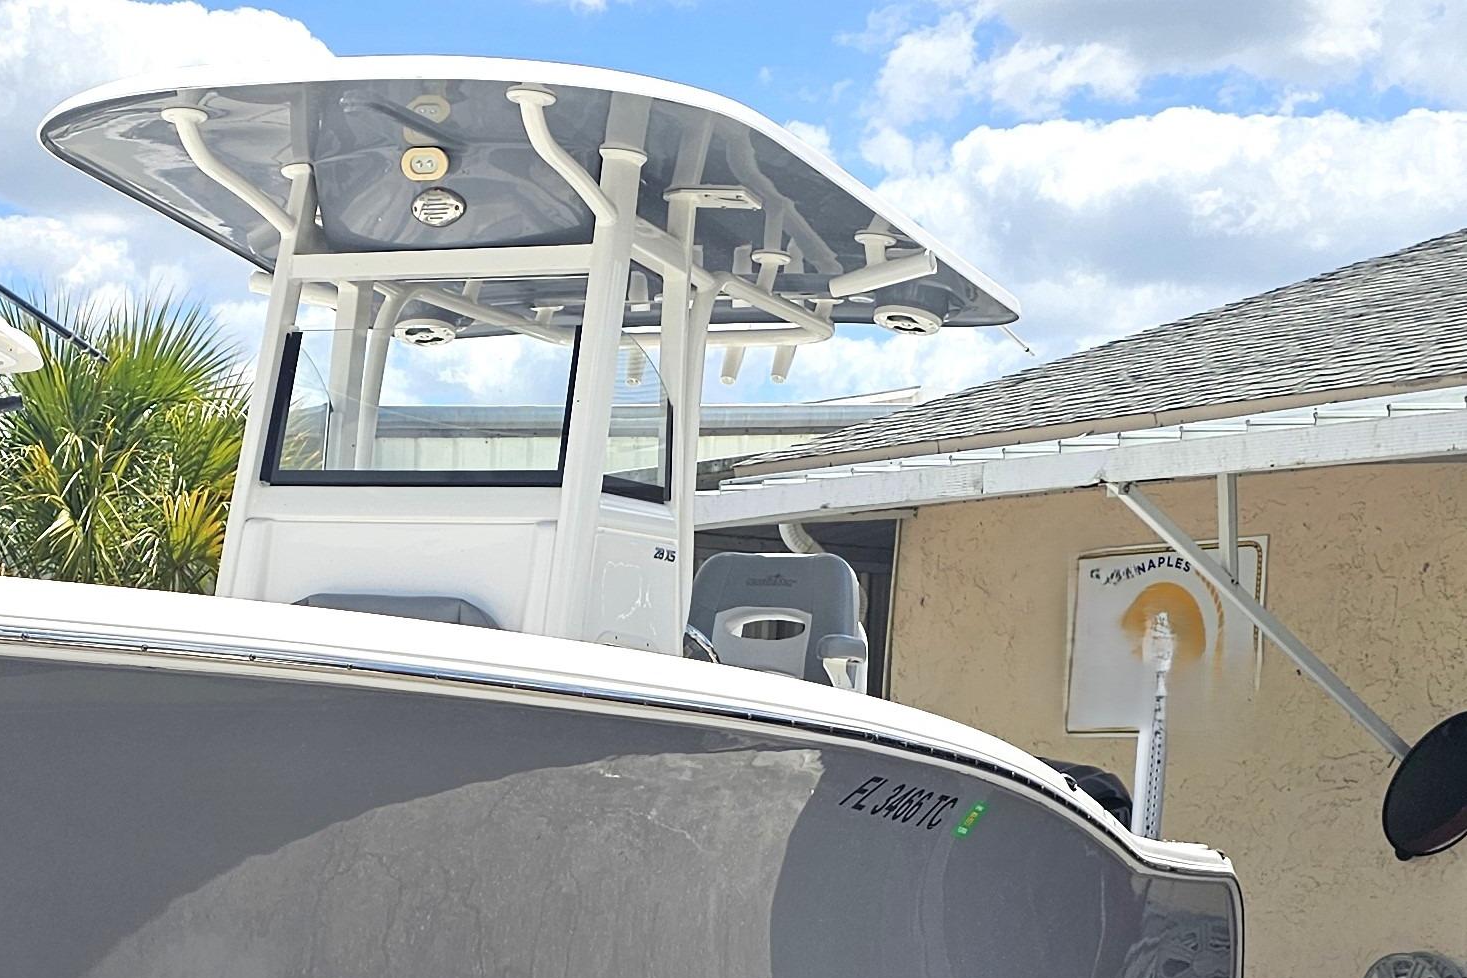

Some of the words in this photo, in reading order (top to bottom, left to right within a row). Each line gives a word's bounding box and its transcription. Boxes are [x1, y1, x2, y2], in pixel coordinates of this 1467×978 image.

[1136, 555, 1191, 576] NAPLES
[839, 775, 889, 811] FL
[870, 783, 935, 824] 3466
[916, 794, 959, 830] TC
